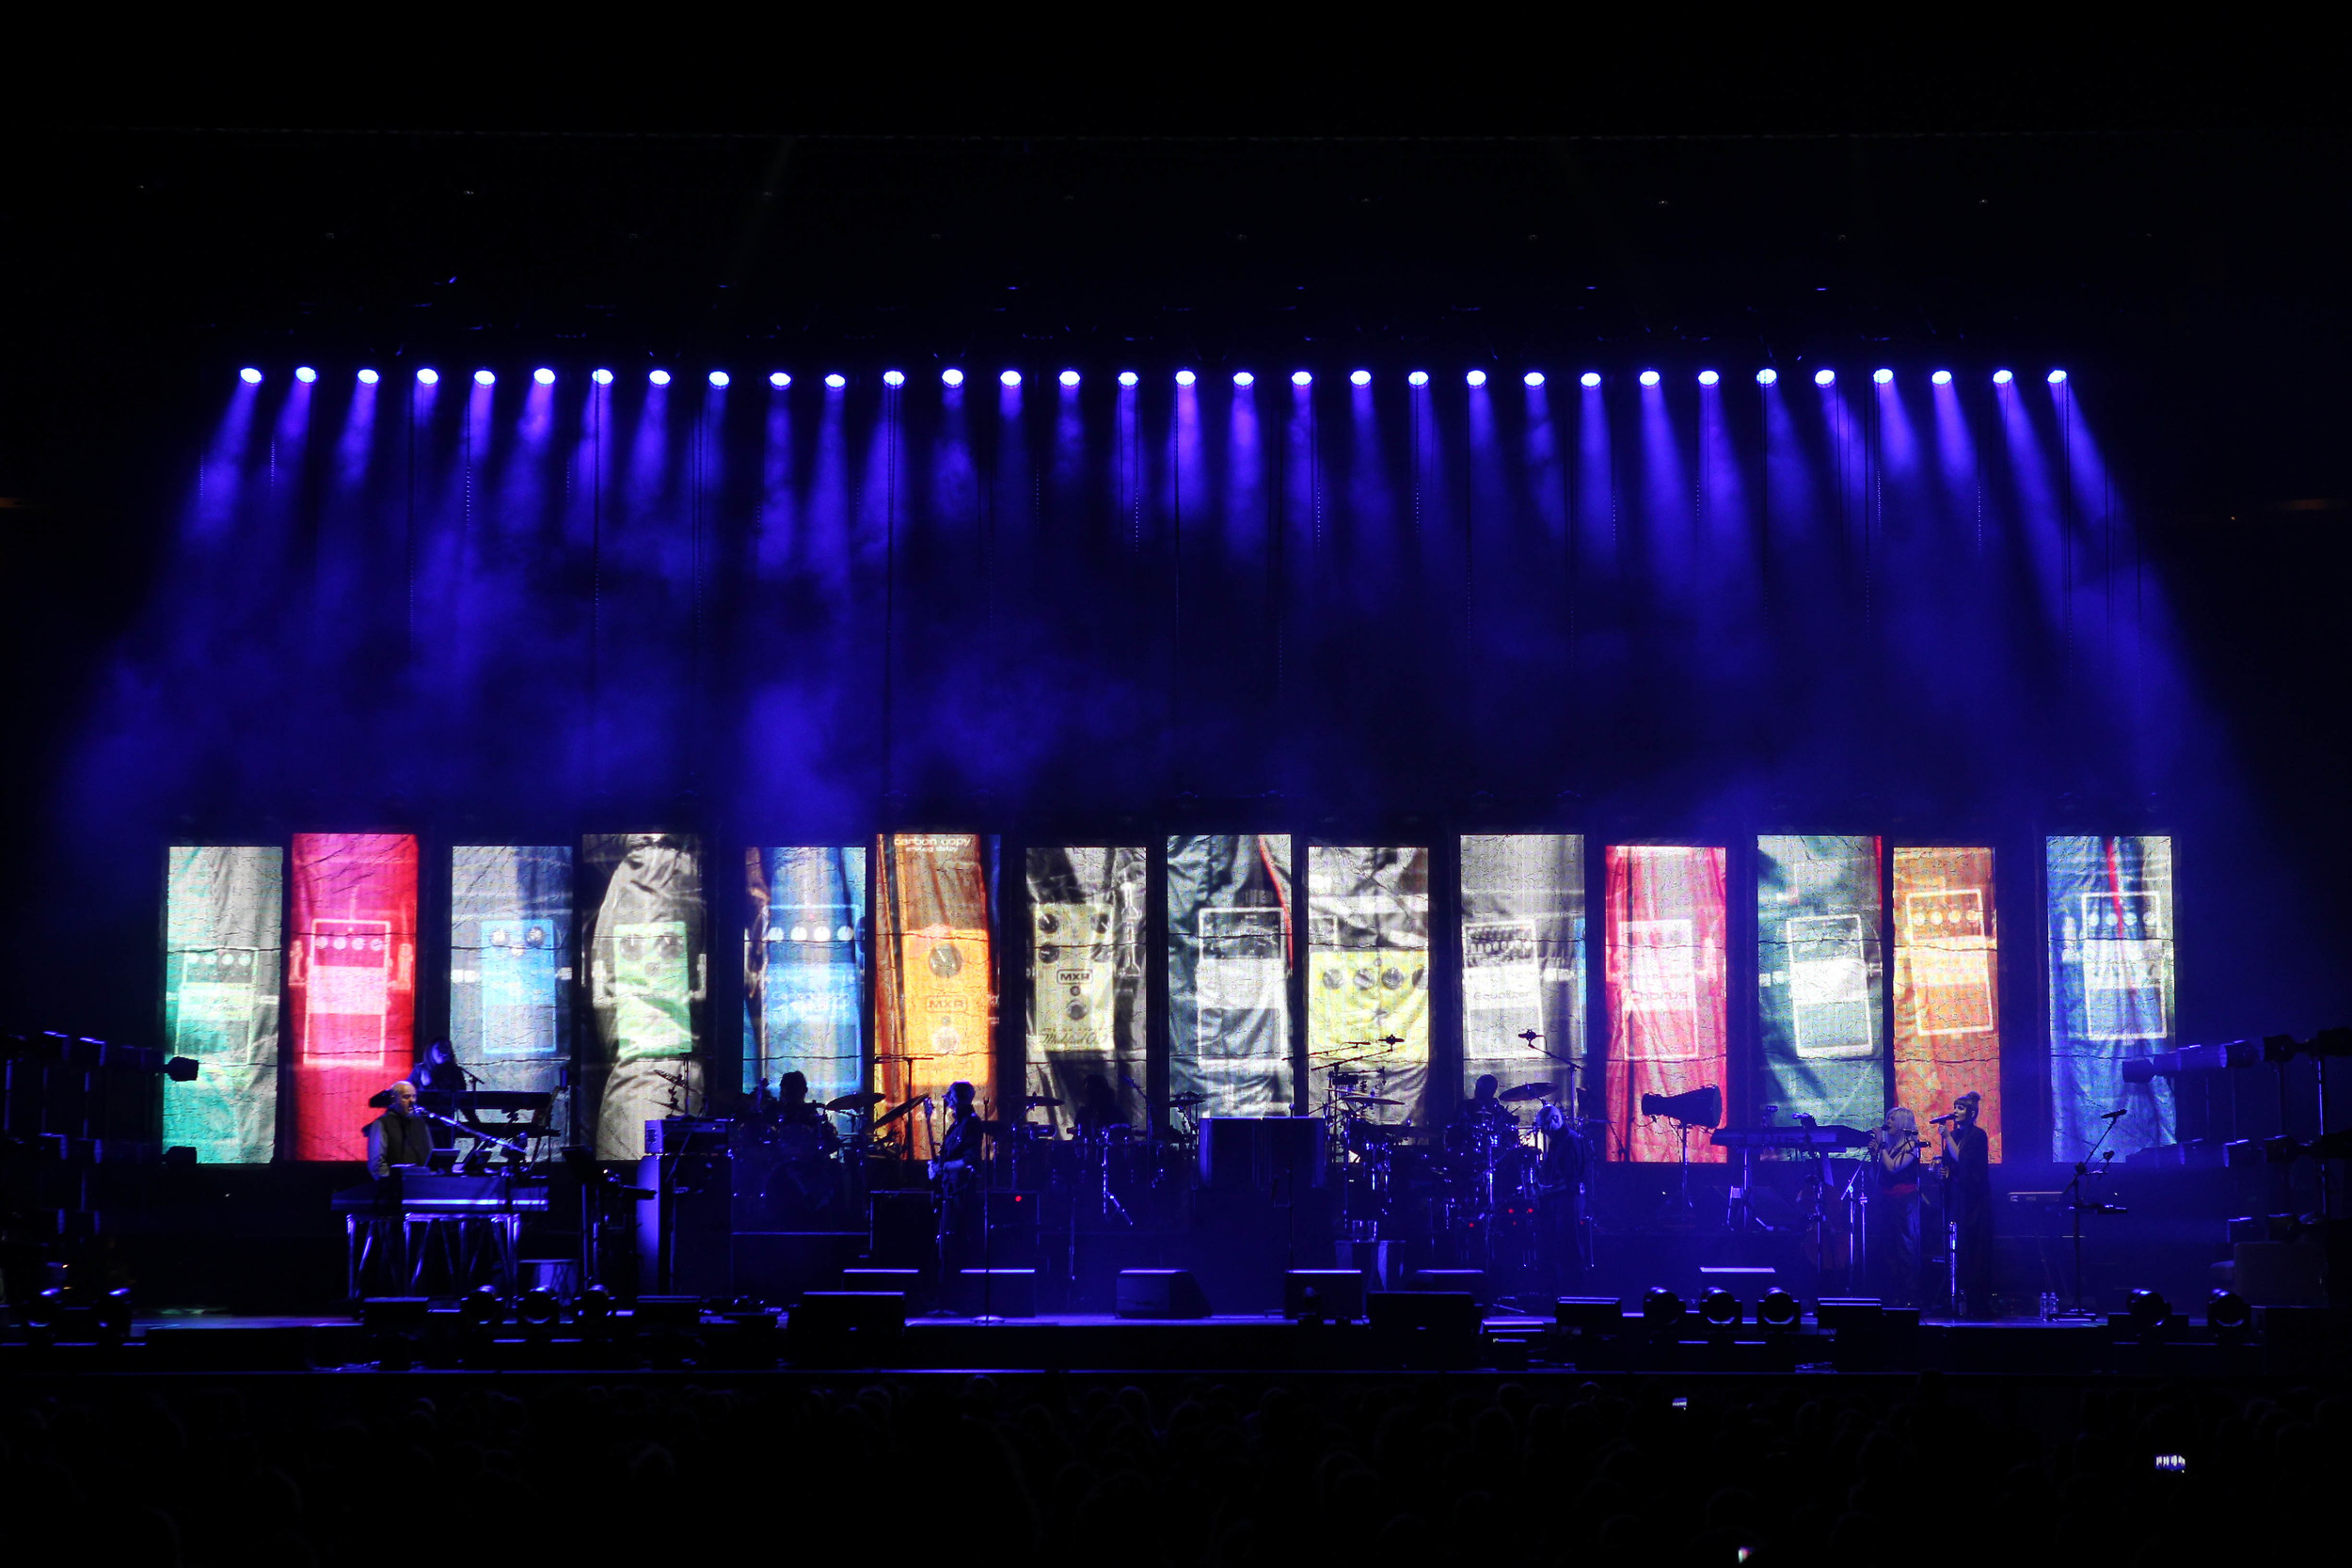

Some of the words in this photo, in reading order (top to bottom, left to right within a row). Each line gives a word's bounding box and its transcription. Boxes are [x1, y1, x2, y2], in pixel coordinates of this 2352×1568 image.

[894, 836, 937, 847] carbon
[941, 837, 973, 847] copy
[1059, 972, 1090, 982] MXR
[927, 999, 965, 1009] MXR
